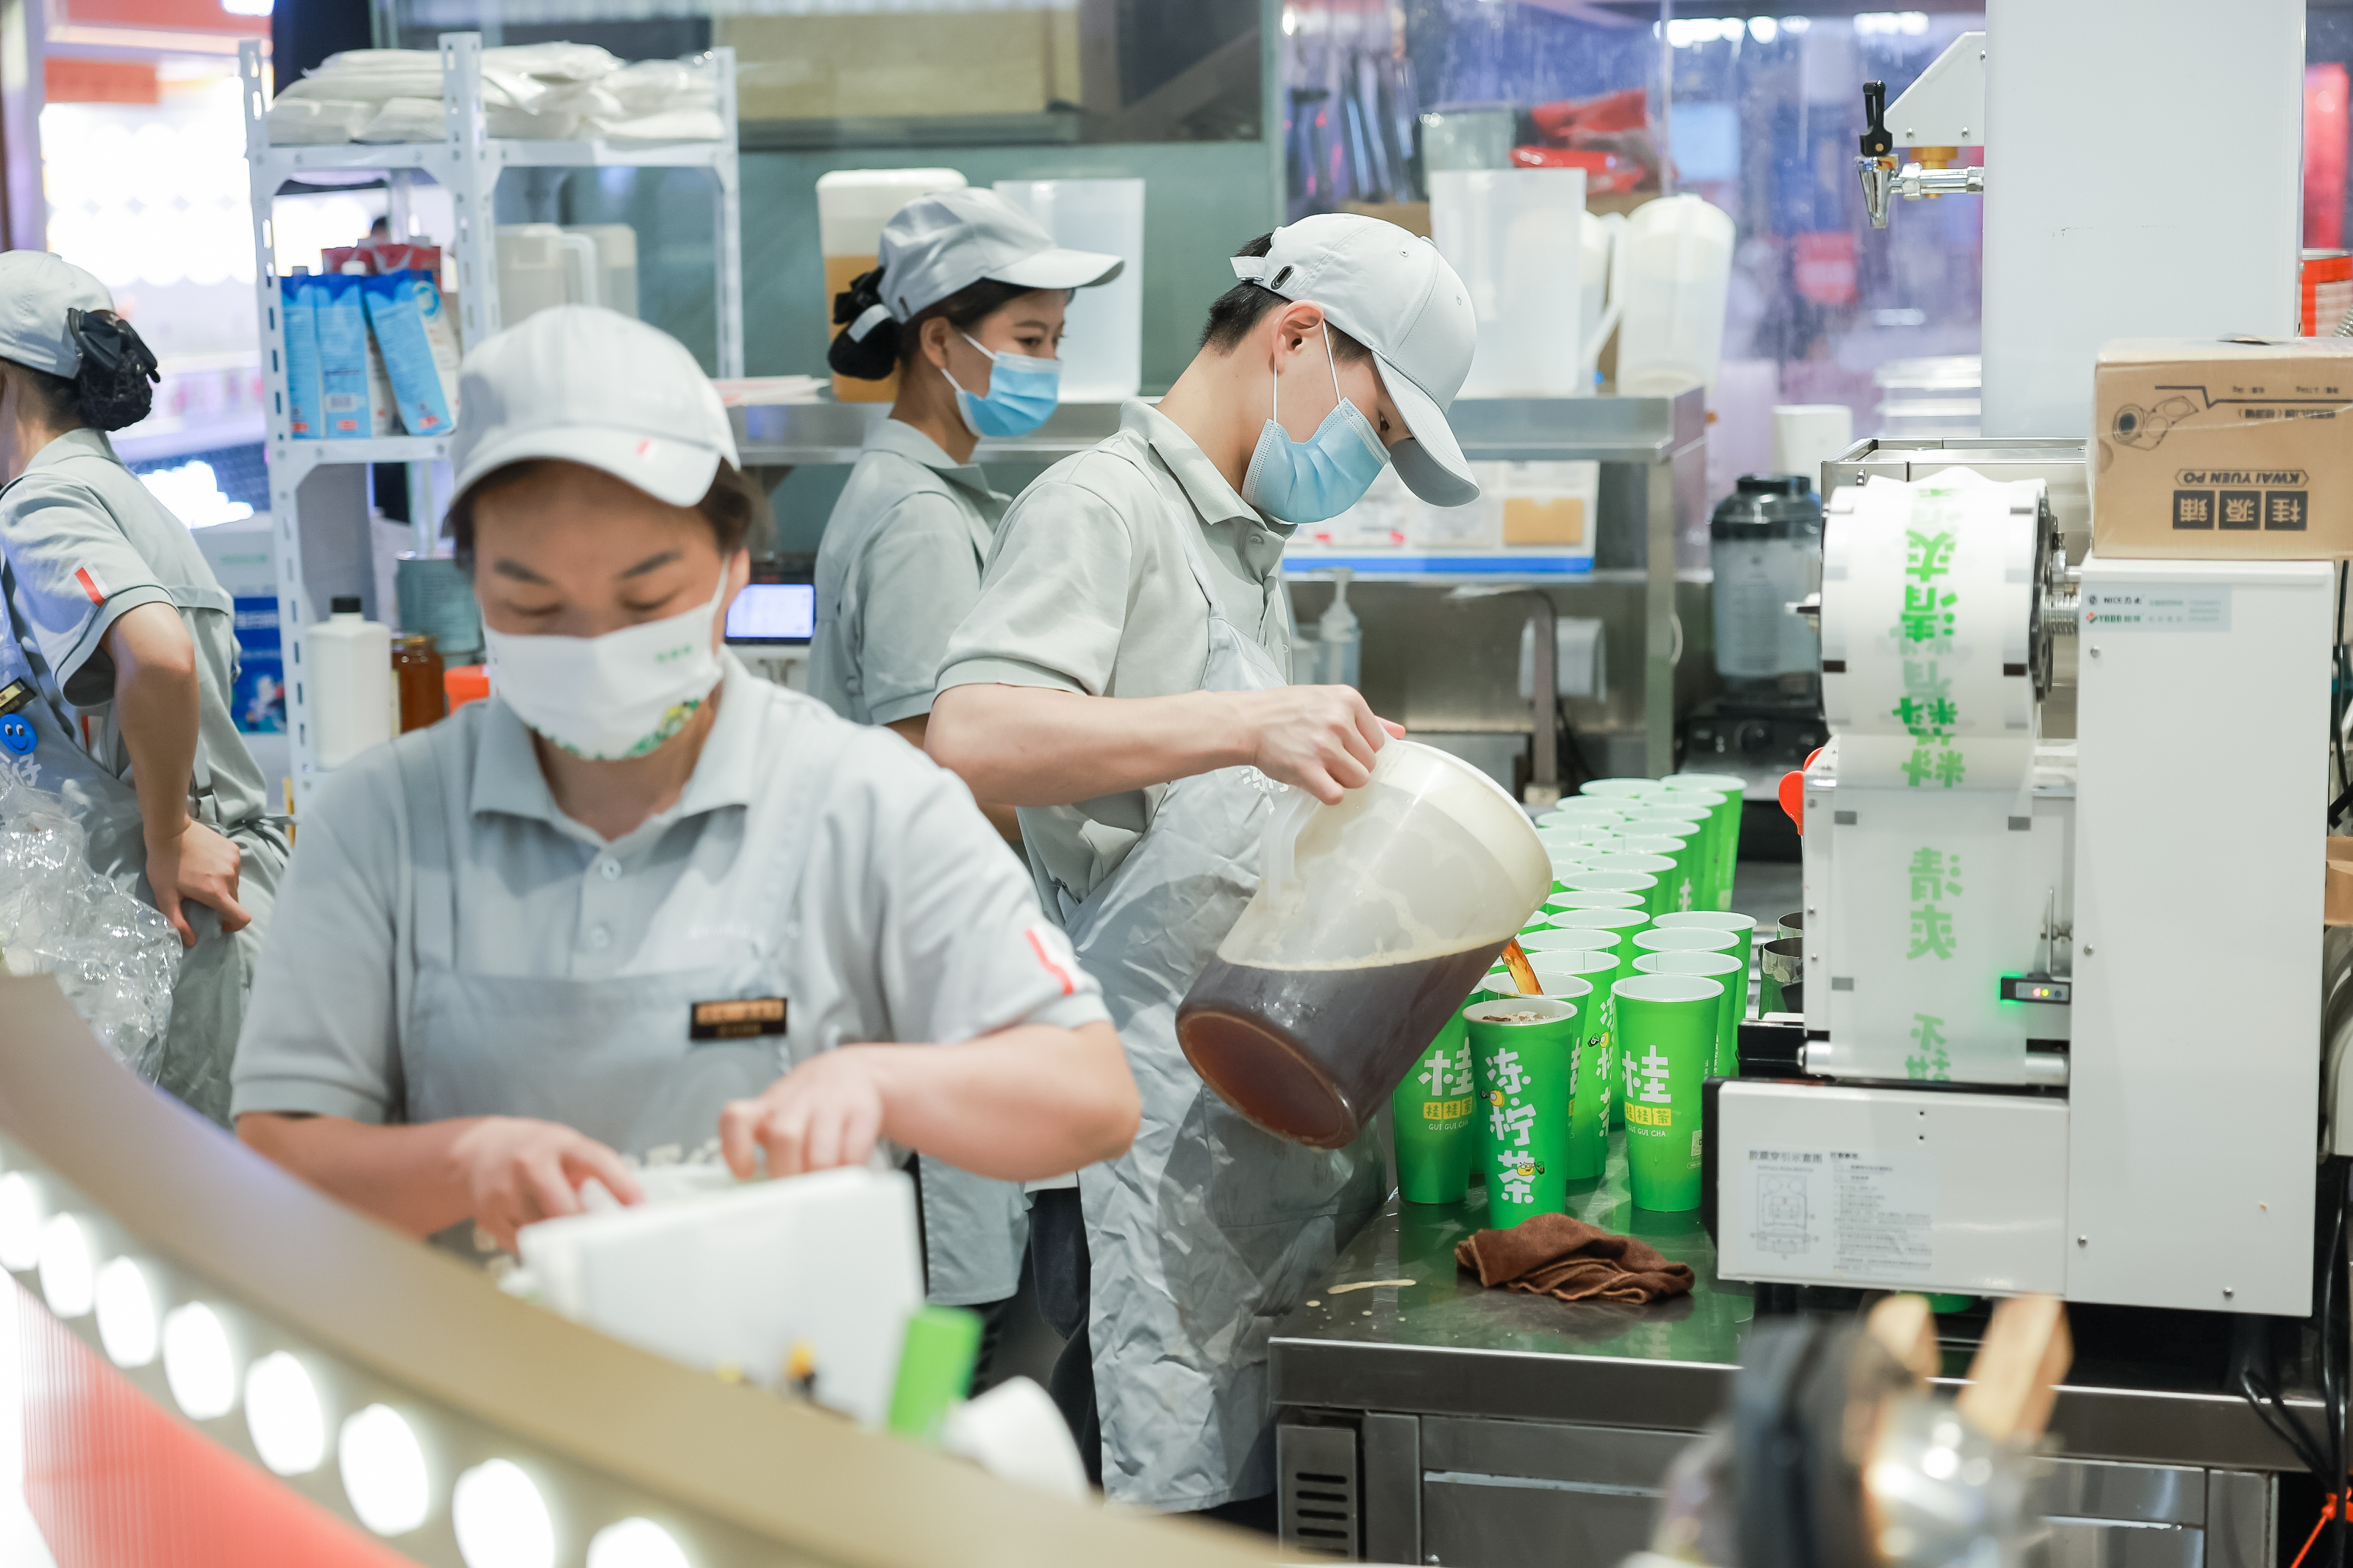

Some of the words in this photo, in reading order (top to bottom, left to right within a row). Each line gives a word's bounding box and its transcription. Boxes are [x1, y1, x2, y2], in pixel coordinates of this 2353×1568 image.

[2183, 472, 2207, 484] PO
[2210, 472, 2252, 484] YUEN
[2255, 472, 2300, 484] KWAI
[1621, 1045, 1671, 1103] 桂
[1625, 1103, 1671, 1125] 桂桂茶
[1428, 1123, 1442, 1131] GUI
[1444, 1122, 1457, 1130] GUI
[1485, 1048, 1537, 1204] 冻柠茶
[1628, 1124, 1636, 1134] GUI
[1638, 1128, 1649, 1136] GUI
